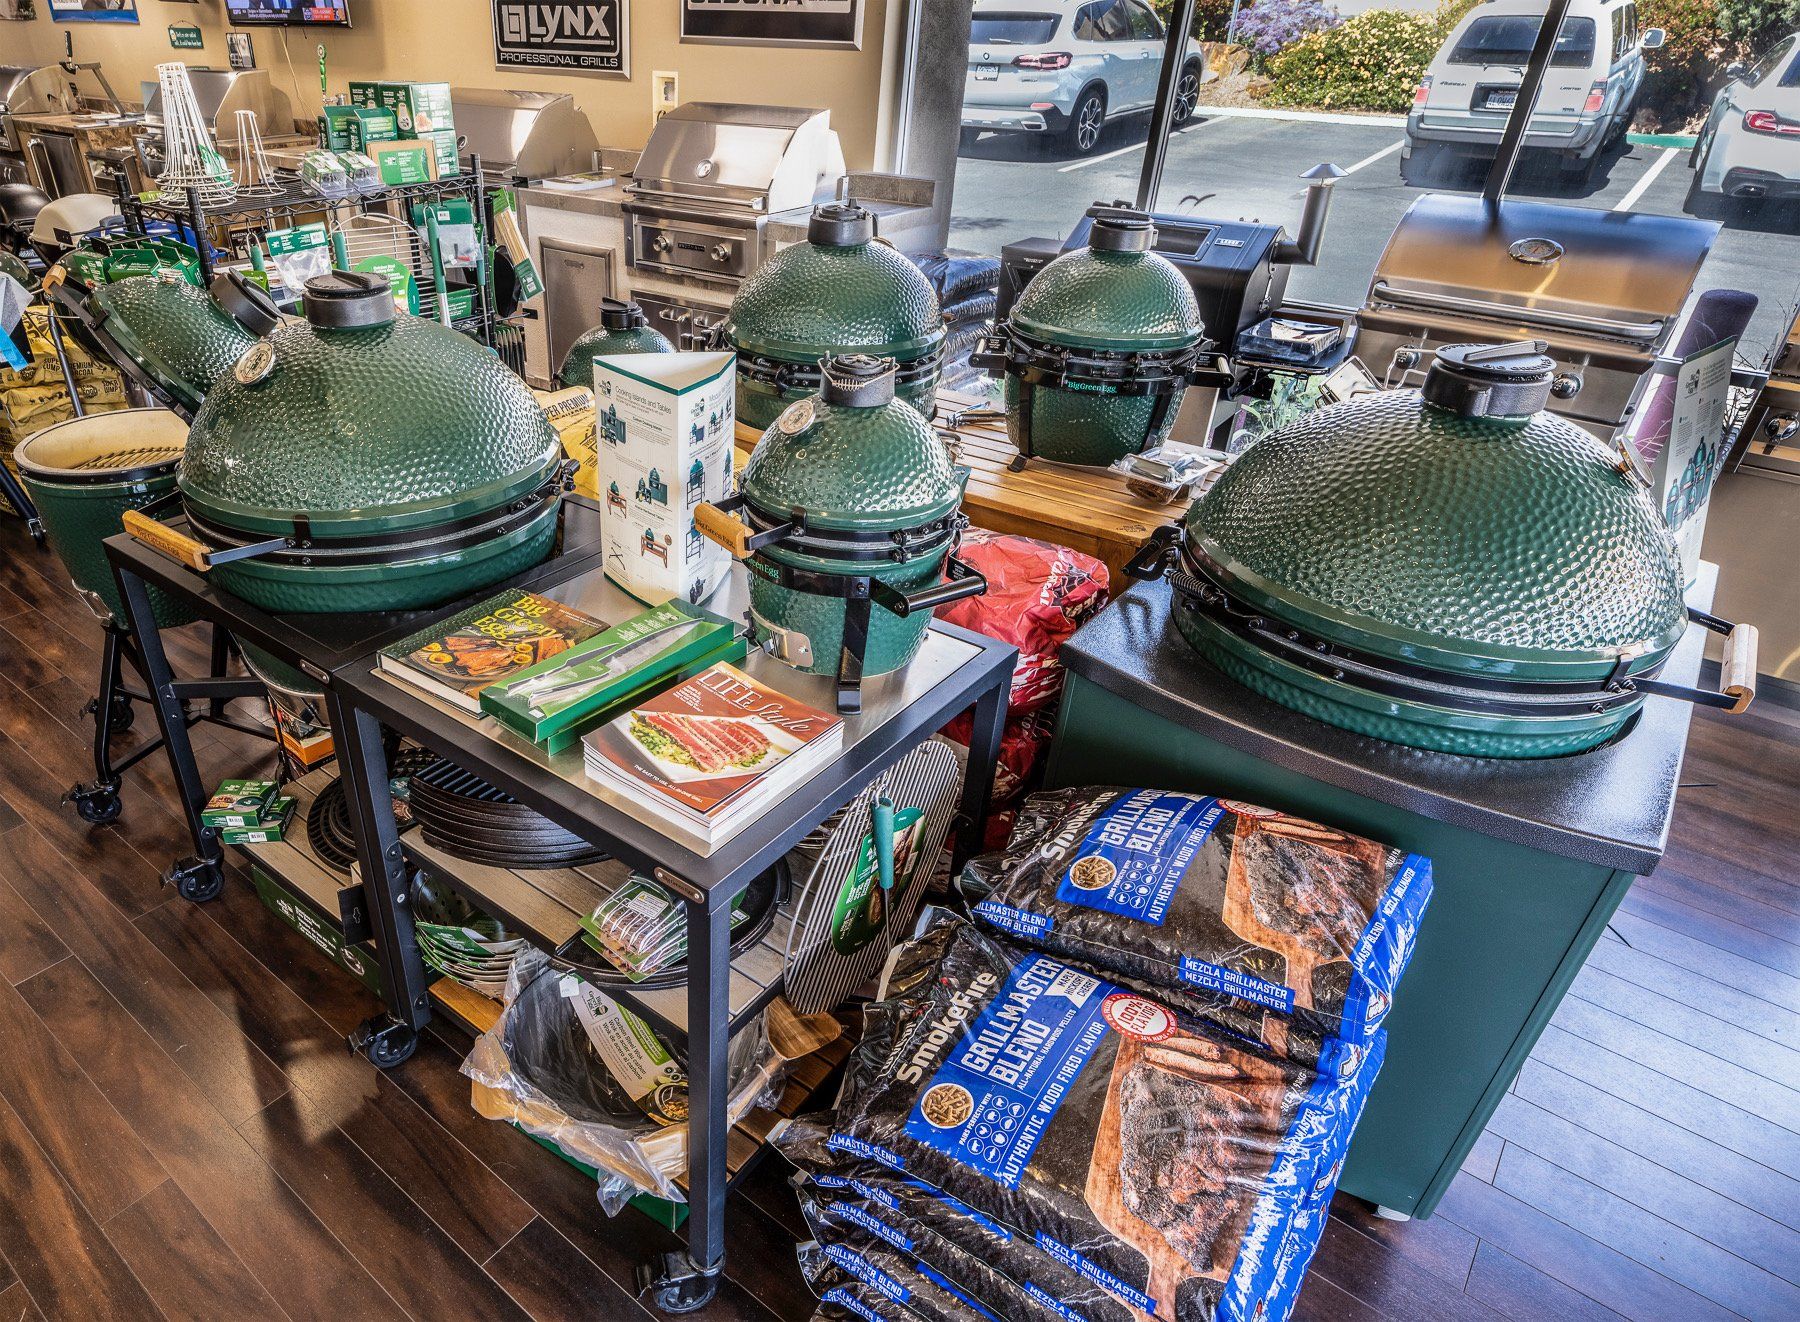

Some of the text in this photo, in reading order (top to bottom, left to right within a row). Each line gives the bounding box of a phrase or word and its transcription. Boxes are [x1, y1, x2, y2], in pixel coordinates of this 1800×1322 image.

[528, 5, 610, 42] LYNX
[500, 52, 618, 67] PROFESSIONAL GRILLS
[615, 385, 672, 415] Cooking Islands and Tables
[494, 608, 557, 637] Green
[511, 596, 552, 618] Big
[472, 615, 515, 646] Egg
[698, 669, 762, 709] LIFE
[748, 703, 813, 732] Style
[1125, 807, 1175, 852] BLEND
[1148, 808, 1223, 921] AUTHENTIC WOOD FIRED FLAVOR
[1013, 921, 1039, 935] BLEND
[1021, 912, 1046, 926] BLEND
[1366, 920, 1385, 943] BLEND
[1057, 971, 1076, 987] MAPLE
[1064, 975, 1085, 996] HICKORY
[1076, 978, 1096, 997] CHERRY
[1185, 959, 1288, 999] MEZCLA GRILLMASTER
[1185, 971, 1287, 1011] MEZCLA GRILLMASTER
[588, 990, 598, 1008] Green
[961, 958, 1064, 1073] GRILLMASTER
[1118, 1000, 1144, 1025] 100%
[612, 1016, 643, 1060] Carbon Steel Wok
[896, 972, 998, 1085] SmokeFire
[1131, 1005, 1158, 1033] FLAVOR
[601, 1022, 612, 1035] Wok
[613, 1041, 625, 1057] acero
[626, 1060, 642, 1081] carbono
[607, 1019, 618, 1032] Wok
[618, 1038, 630, 1052] acier
[632, 1057, 646, 1075] carbon
[988, 1019, 1051, 1085] BLEND
[1017, 1008, 1077, 1091] ALL-NATURAL HARDWOOD PELLETS
[959, 1092, 993, 1146] PAIRS PERFECTLY WITH
[1003, 1021, 1106, 1185] AUTHENTIC WOOD FIRED FLAVOR
[873, 1145, 898, 1164] BLEND
[828, 1201, 907, 1247] GRILLMASTER BLEND
[825, 1244, 903, 1297] GRILLMASTER BLEND
[1041, 1235, 1078, 1263] MEZCLA
[1081, 1260, 1148, 1306] GRILLMASTER
[1030, 1285, 1066, 1315] MEZCLA
